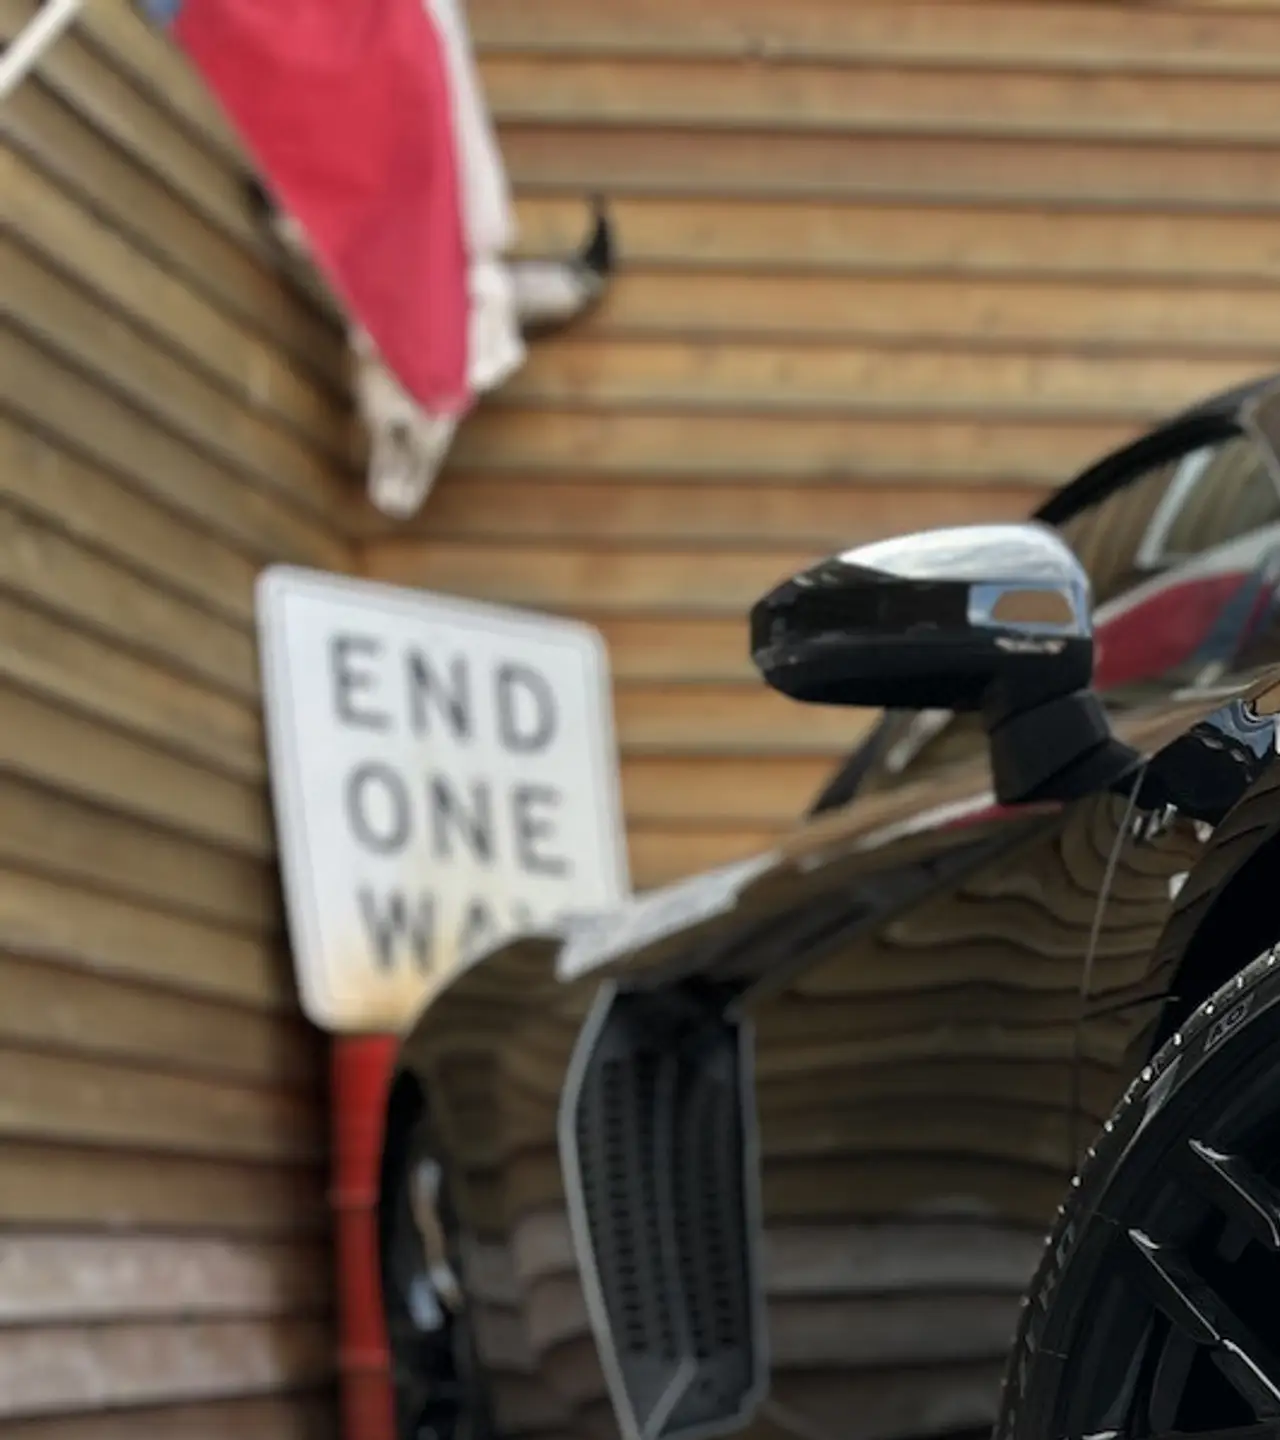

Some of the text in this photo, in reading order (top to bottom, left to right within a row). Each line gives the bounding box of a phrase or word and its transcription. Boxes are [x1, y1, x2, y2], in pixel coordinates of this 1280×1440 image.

[326, 634, 560, 754] END
[344, 761, 573, 878] ONE
[355, 884, 537, 978] WA
